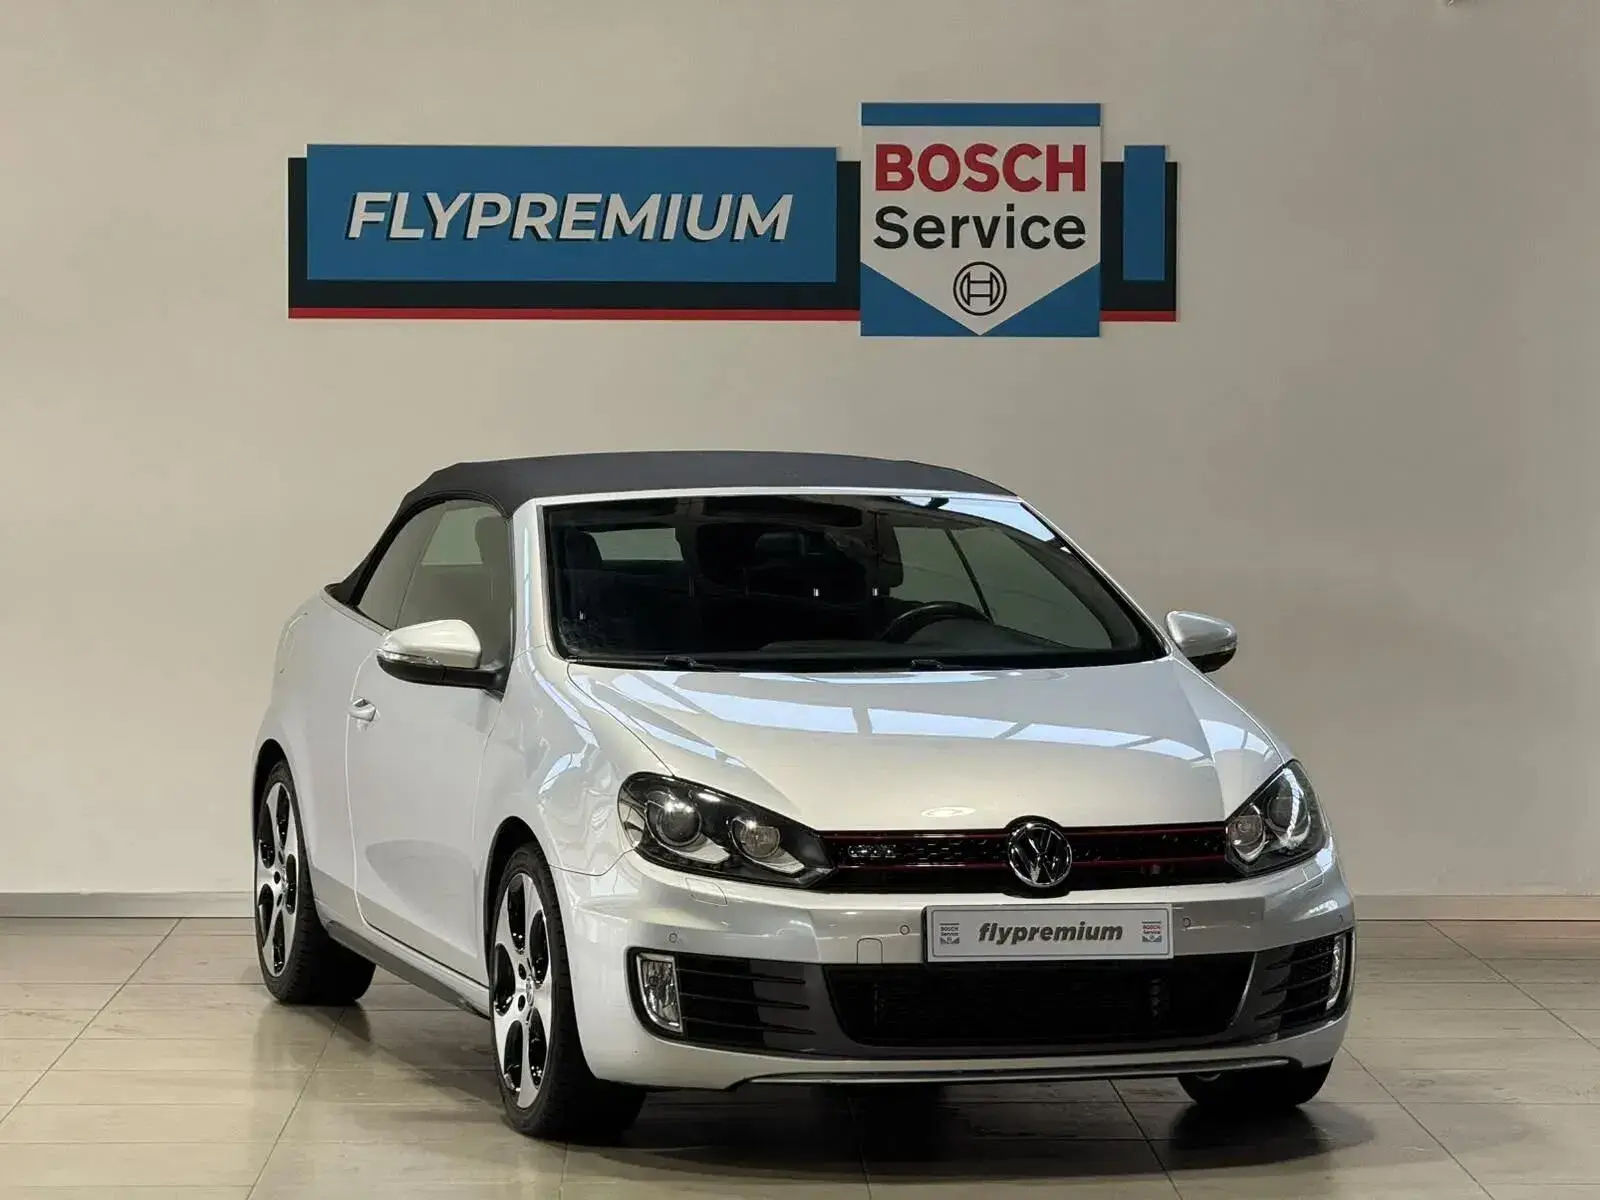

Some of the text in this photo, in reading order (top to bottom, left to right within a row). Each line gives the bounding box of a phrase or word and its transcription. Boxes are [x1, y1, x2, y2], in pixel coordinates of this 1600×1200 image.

[875, 143, 1087, 193] BOSCH
[347, 191, 794, 242] FLYPREMIUM
[873, 203, 1087, 250] Service
[978, 922, 1123, 946] flypremium
